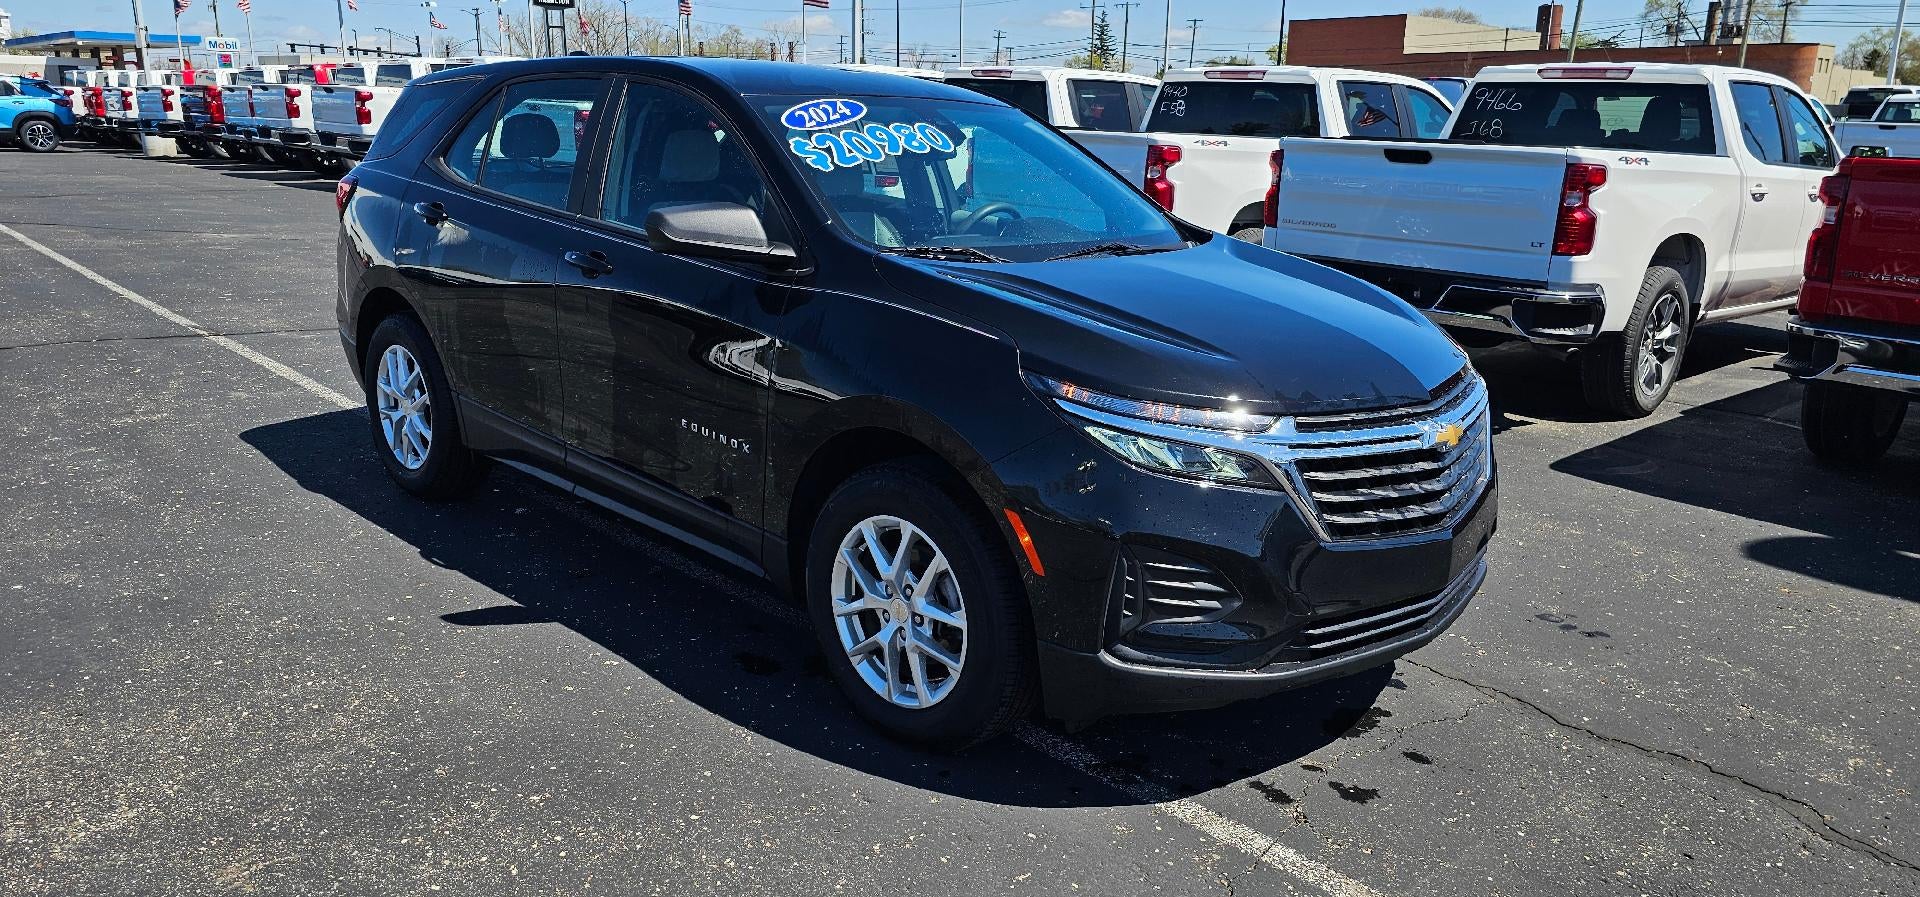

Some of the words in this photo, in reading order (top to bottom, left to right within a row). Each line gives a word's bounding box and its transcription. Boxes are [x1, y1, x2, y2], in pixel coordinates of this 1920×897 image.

[208, 40, 238, 50] Mobil
[1475, 87, 1523, 111] 9466
[795, 101, 851, 127] 2024
[789, 123, 954, 172] $20980
[1530, 240, 1546, 248] LT
[681, 418, 750, 454] EQUINOX
